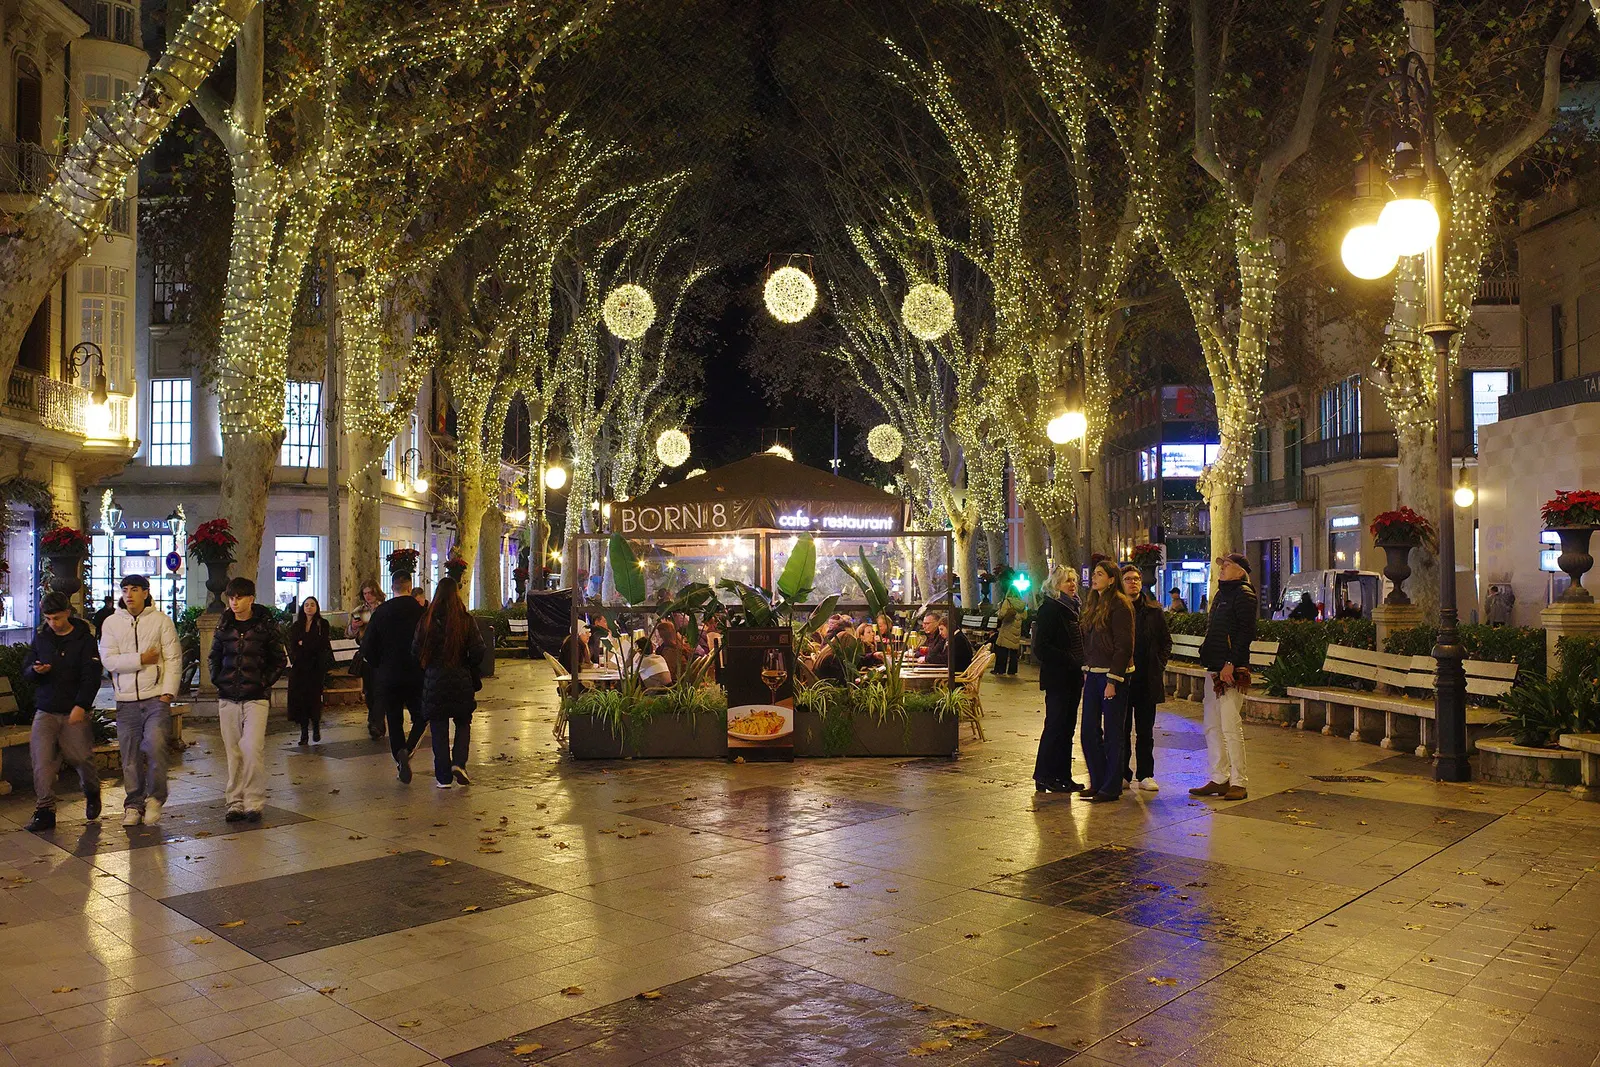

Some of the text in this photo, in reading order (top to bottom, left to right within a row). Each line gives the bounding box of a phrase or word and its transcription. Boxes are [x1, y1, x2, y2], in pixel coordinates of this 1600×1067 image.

[622, 503, 727, 533] BORN 8
[778, 509, 810, 527] cafe
[822, 514, 894, 530] restaurant
